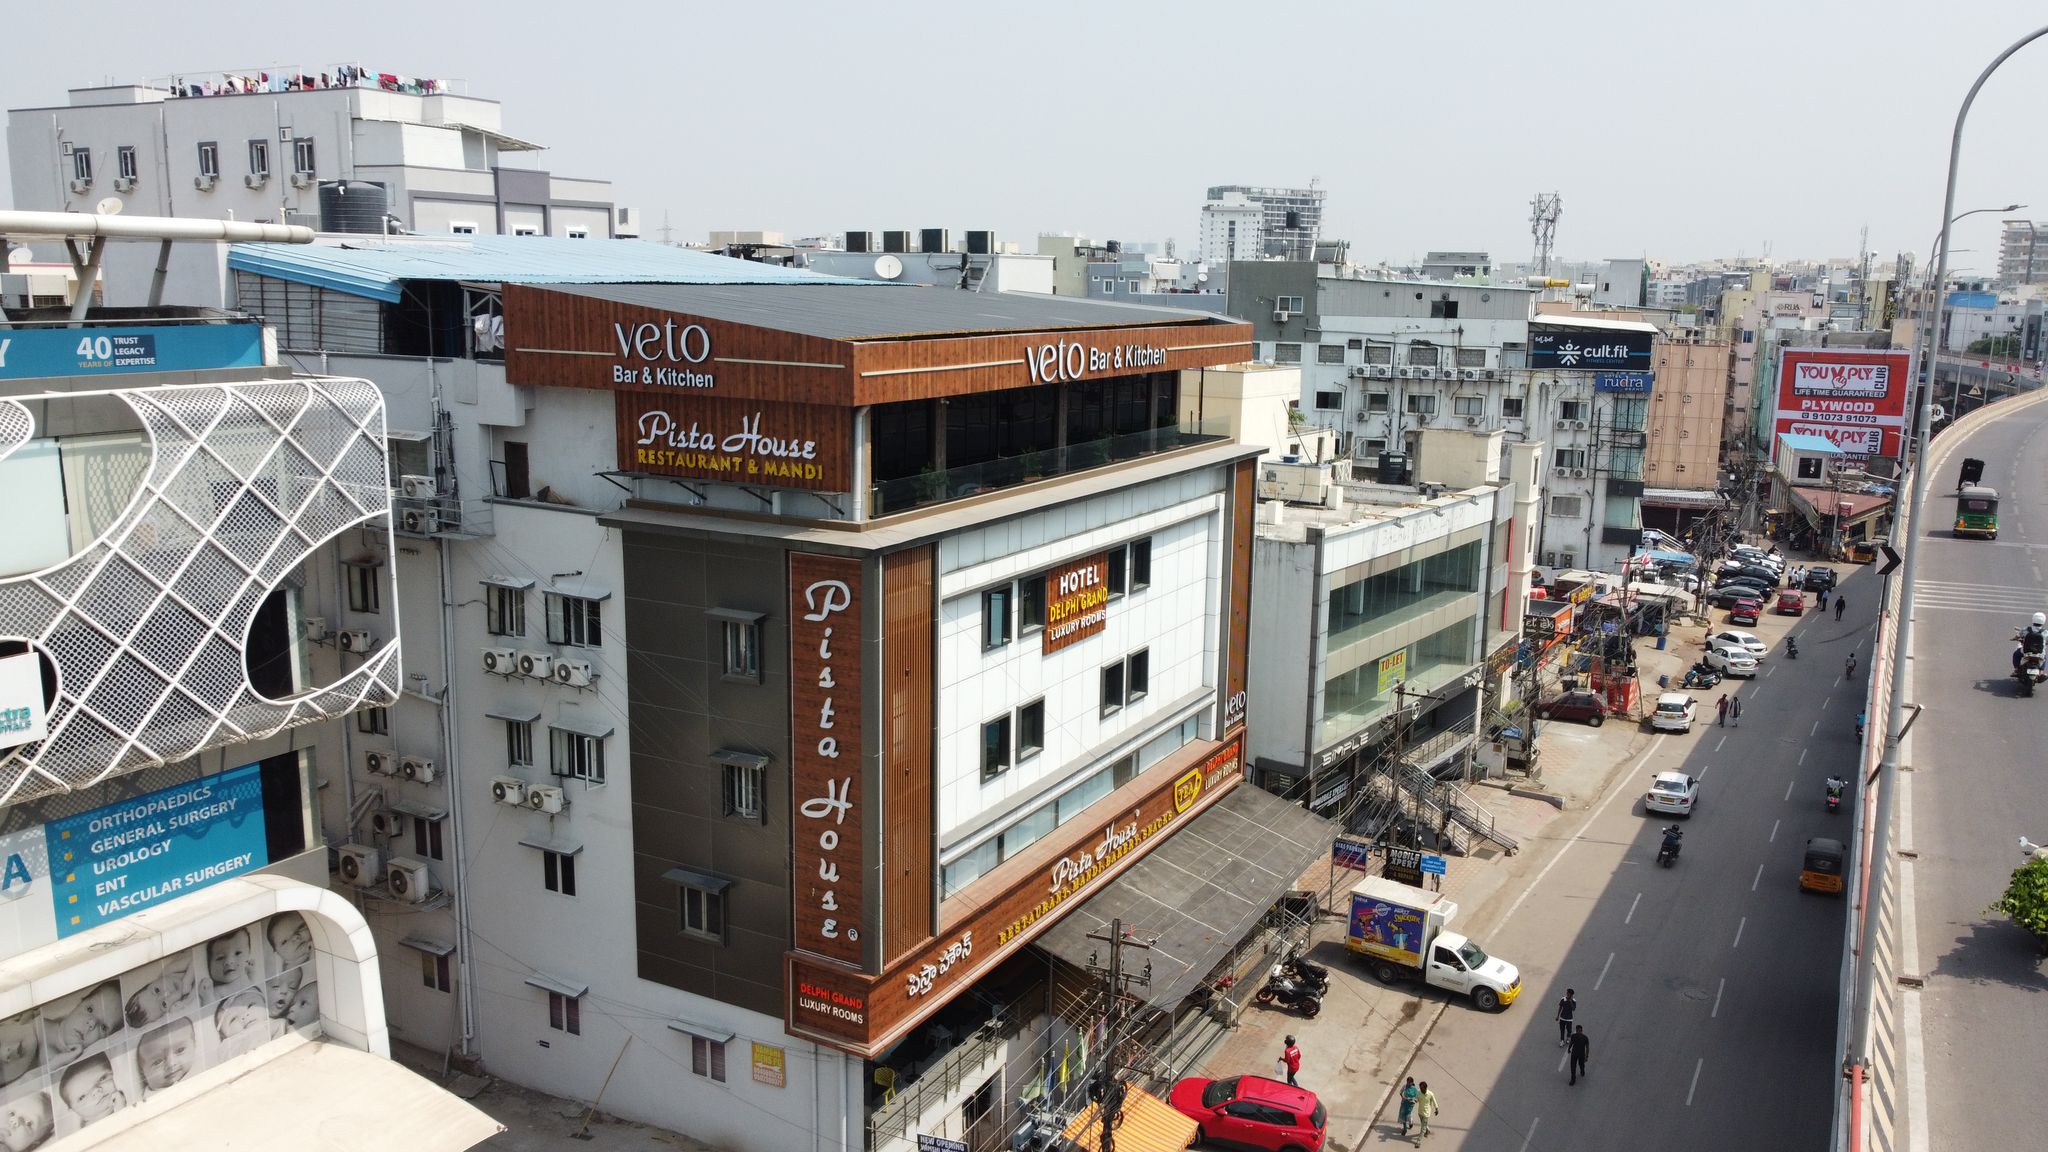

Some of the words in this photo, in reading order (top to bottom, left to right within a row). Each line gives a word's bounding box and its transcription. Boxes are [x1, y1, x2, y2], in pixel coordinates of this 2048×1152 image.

[76, 336, 112, 360] 40
[113, 337, 139, 345] TRUST
[115, 347, 145, 356] LEGACY
[614, 317, 711, 363] veto
[1584, 345, 1628, 358] cult.fit
[115, 357, 156, 366] EXPERTISE
[1027, 337, 1085, 383] veto
[1089, 347, 1111, 371] Bar
[1114, 346, 1123, 369] &
[1125, 343, 1166, 368] Kitchen
[613, 365, 638, 384] Bar
[642, 366, 653, 385] &
[656, 367, 714, 388] Kitchen
[1605, 375, 1643, 388] rudra
[1799, 365, 1829, 379] YOU
[1848, 367, 1874, 380] PLY
[1875, 366, 1886, 390] CLUB
[1801, 400, 1875, 412] PLYWOOD
[1832, 390, 1885, 398] GUARANTEED
[1812, 414, 1843, 422] 91073
[1846, 415, 1877, 423] 91073
[637, 410, 717, 452] Pista
[722, 411, 817, 460] House
[1841, 430, 1868, 443] PLY
[1868, 430, 1880, 453] CLUB
[637, 449, 743, 473] RESTAURANT
[747, 461, 759, 475] &
[764, 461, 823, 481] MANDI
[1060, 565, 1099, 596] HOTEL
[1050, 598, 1079, 622] DELPHI
[1081, 587, 1108, 610] GRAND
[1051, 618, 1080, 641] LUXURY
[1081, 610, 1106, 628] ROOMS
[804, 580, 851, 759] Pista
[1381, 652, 1404, 672] TO-LET
[1322, 732, 1369, 767] SIMPLE
[88, 786, 212, 834] ORTHOPAEDICS
[91, 822, 166, 854] GENERAL
[169, 798, 239, 831] SURGERY
[1141, 810, 1173, 840] SNACKS
[93, 840, 173, 876] UROLOGY
[800, 776, 853, 939] House
[1048, 851, 1092, 893] Pista
[1096, 821, 1137, 860] House
[1390, 849, 1420, 860] MOBILE
[1391, 858, 1418, 869] XPERT
[95, 875, 128, 897] ENT
[97, 878, 182, 917] VASCULAR
[184, 853, 252, 894] SURGERY
[800, 983, 830, 1000] DELPHI
[831, 992, 863, 1010] GRAND
[800, 997, 831, 1015] LUXURY
[832, 1006, 864, 1024] ROOMS
[920, 1136, 935, 1145] NEW
[936, 1140, 965, 1151] OPENING
